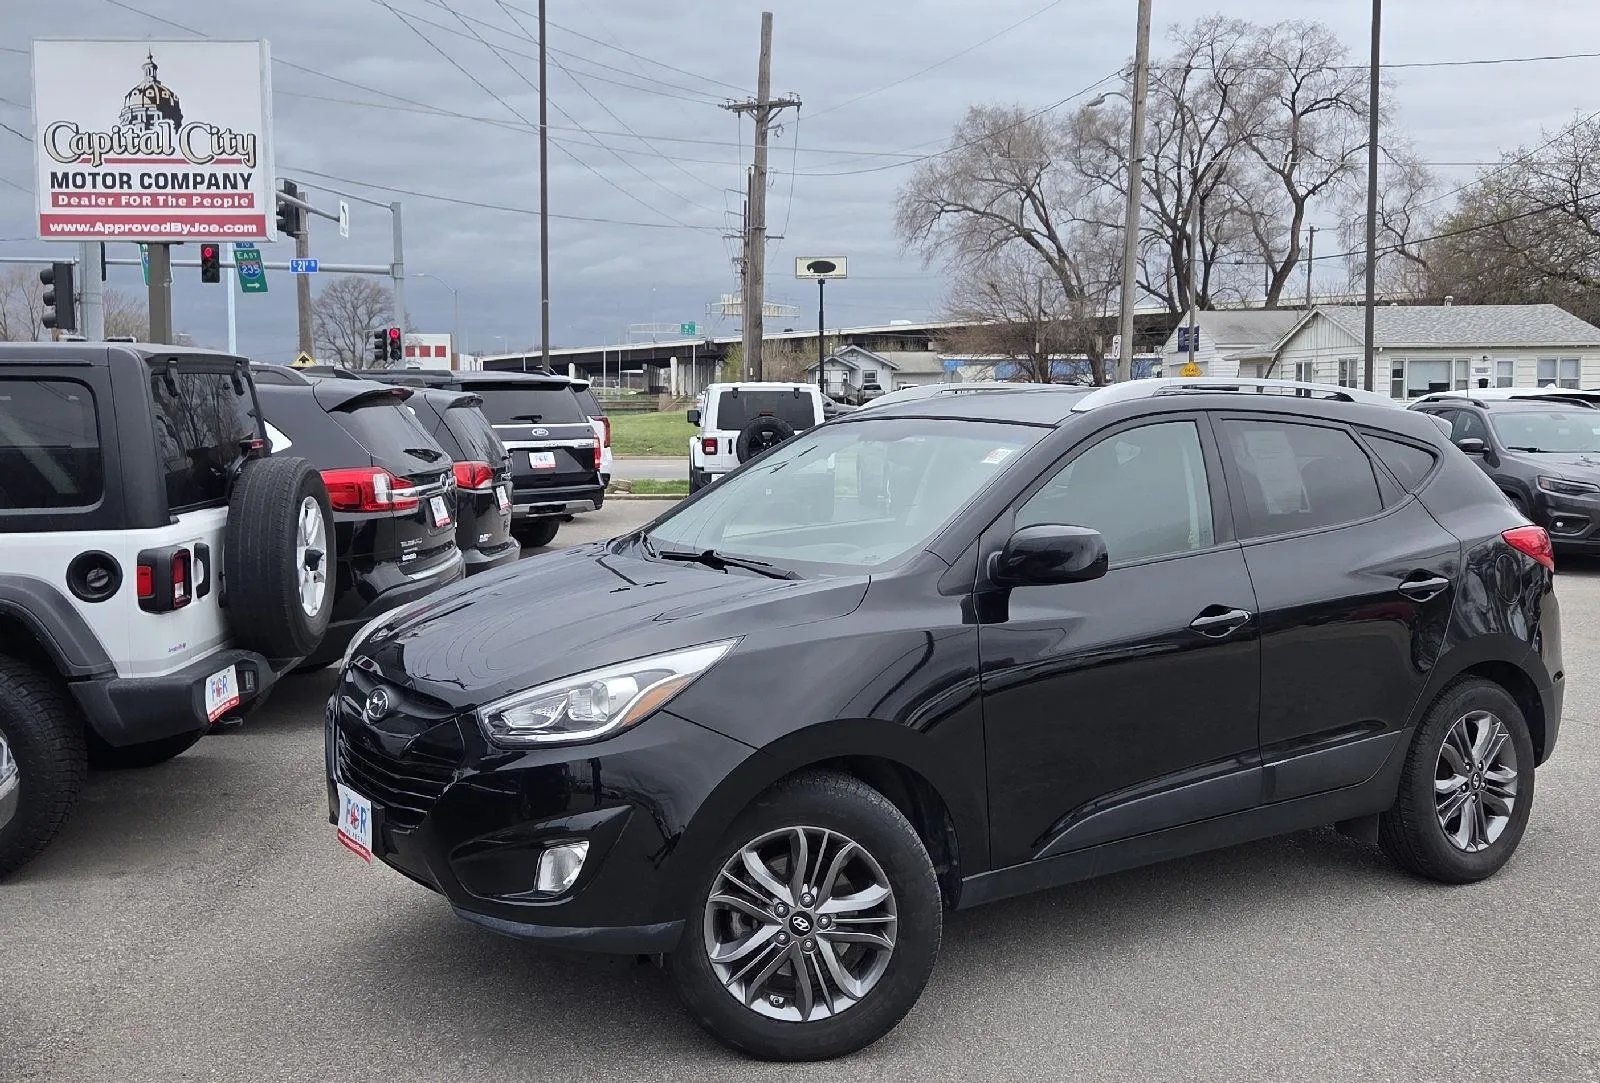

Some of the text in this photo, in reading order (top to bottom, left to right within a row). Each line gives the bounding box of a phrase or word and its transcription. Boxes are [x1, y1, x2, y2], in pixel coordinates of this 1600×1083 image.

[44, 121, 256, 168] Capital City
[51, 171, 252, 190] MOTOR COMPANY
[58, 195, 114, 206] Dealer
[121, 195, 151, 206] FOR
[157, 195, 187, 206] The
[49, 221, 257, 235] www.ApprovedByJoe.com
[236, 251, 257, 260] EAST
[241, 264, 260, 274] 235
